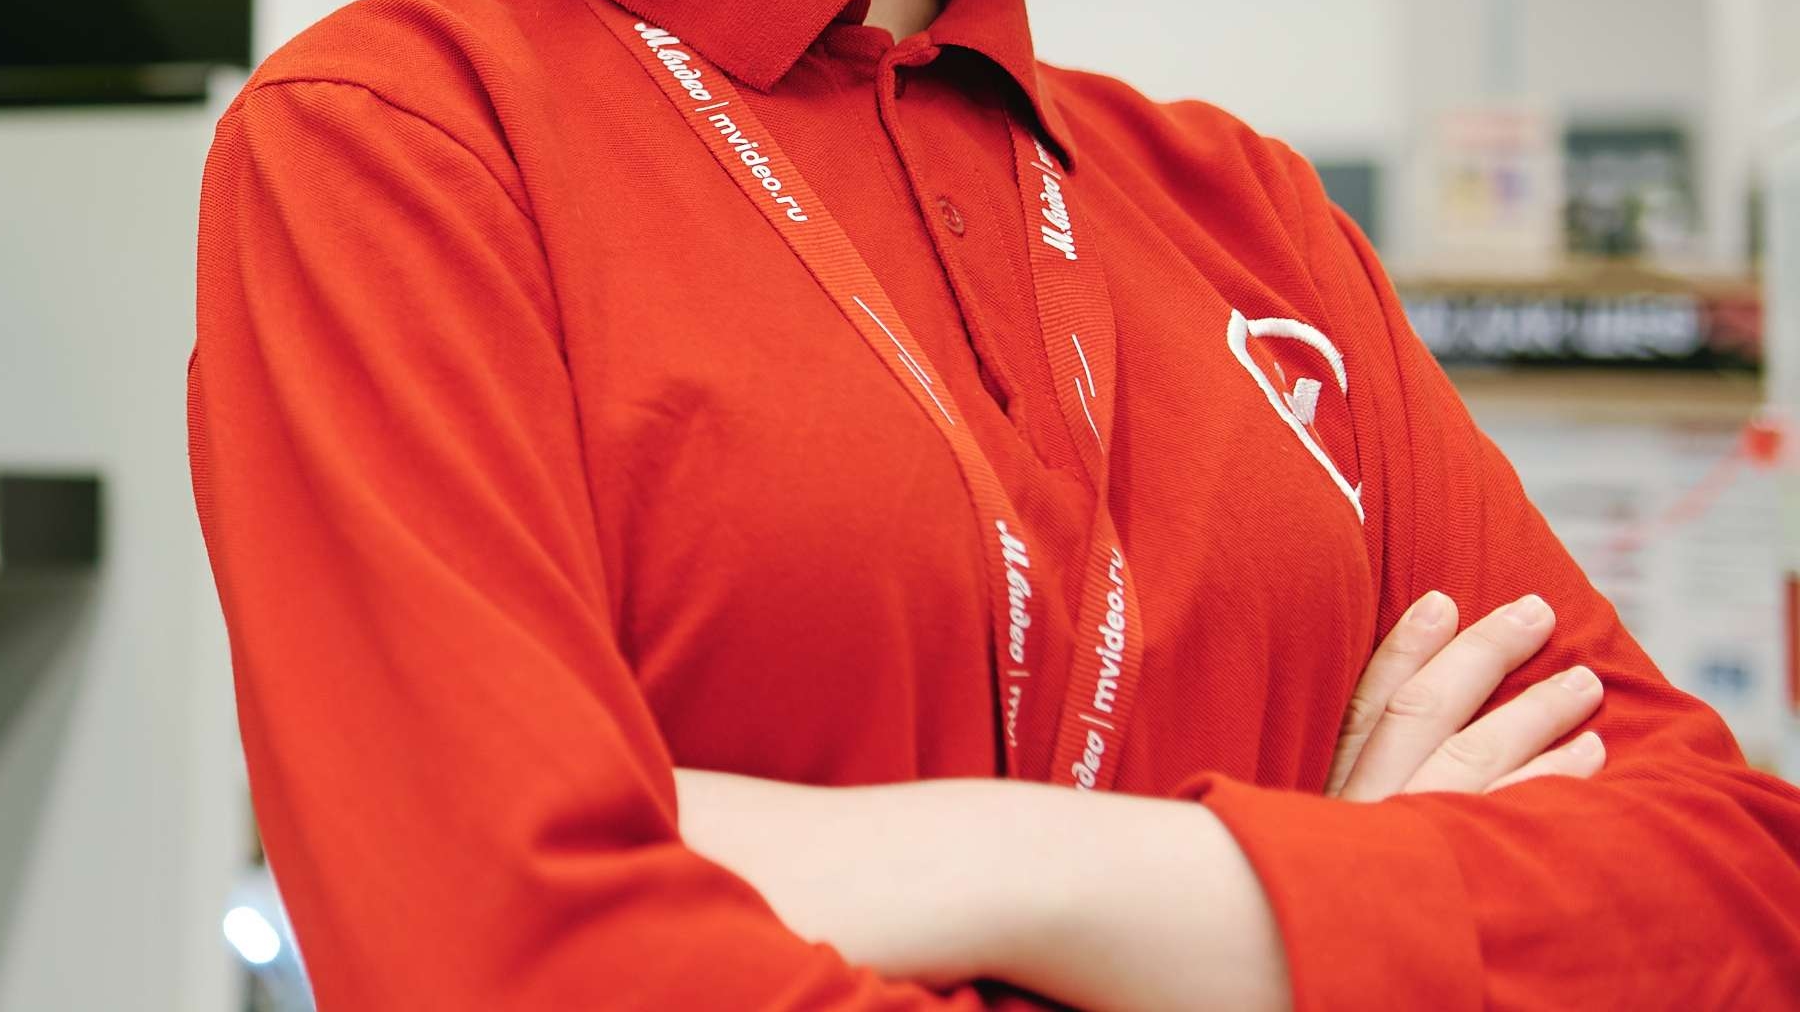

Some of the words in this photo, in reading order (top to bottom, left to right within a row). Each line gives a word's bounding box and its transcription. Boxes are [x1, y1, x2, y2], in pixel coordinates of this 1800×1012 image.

[634, 22, 712, 101] М.видео
[708, 113, 809, 222] mvideo.ru
[1093, 547, 1126, 714] mvideo.ru
